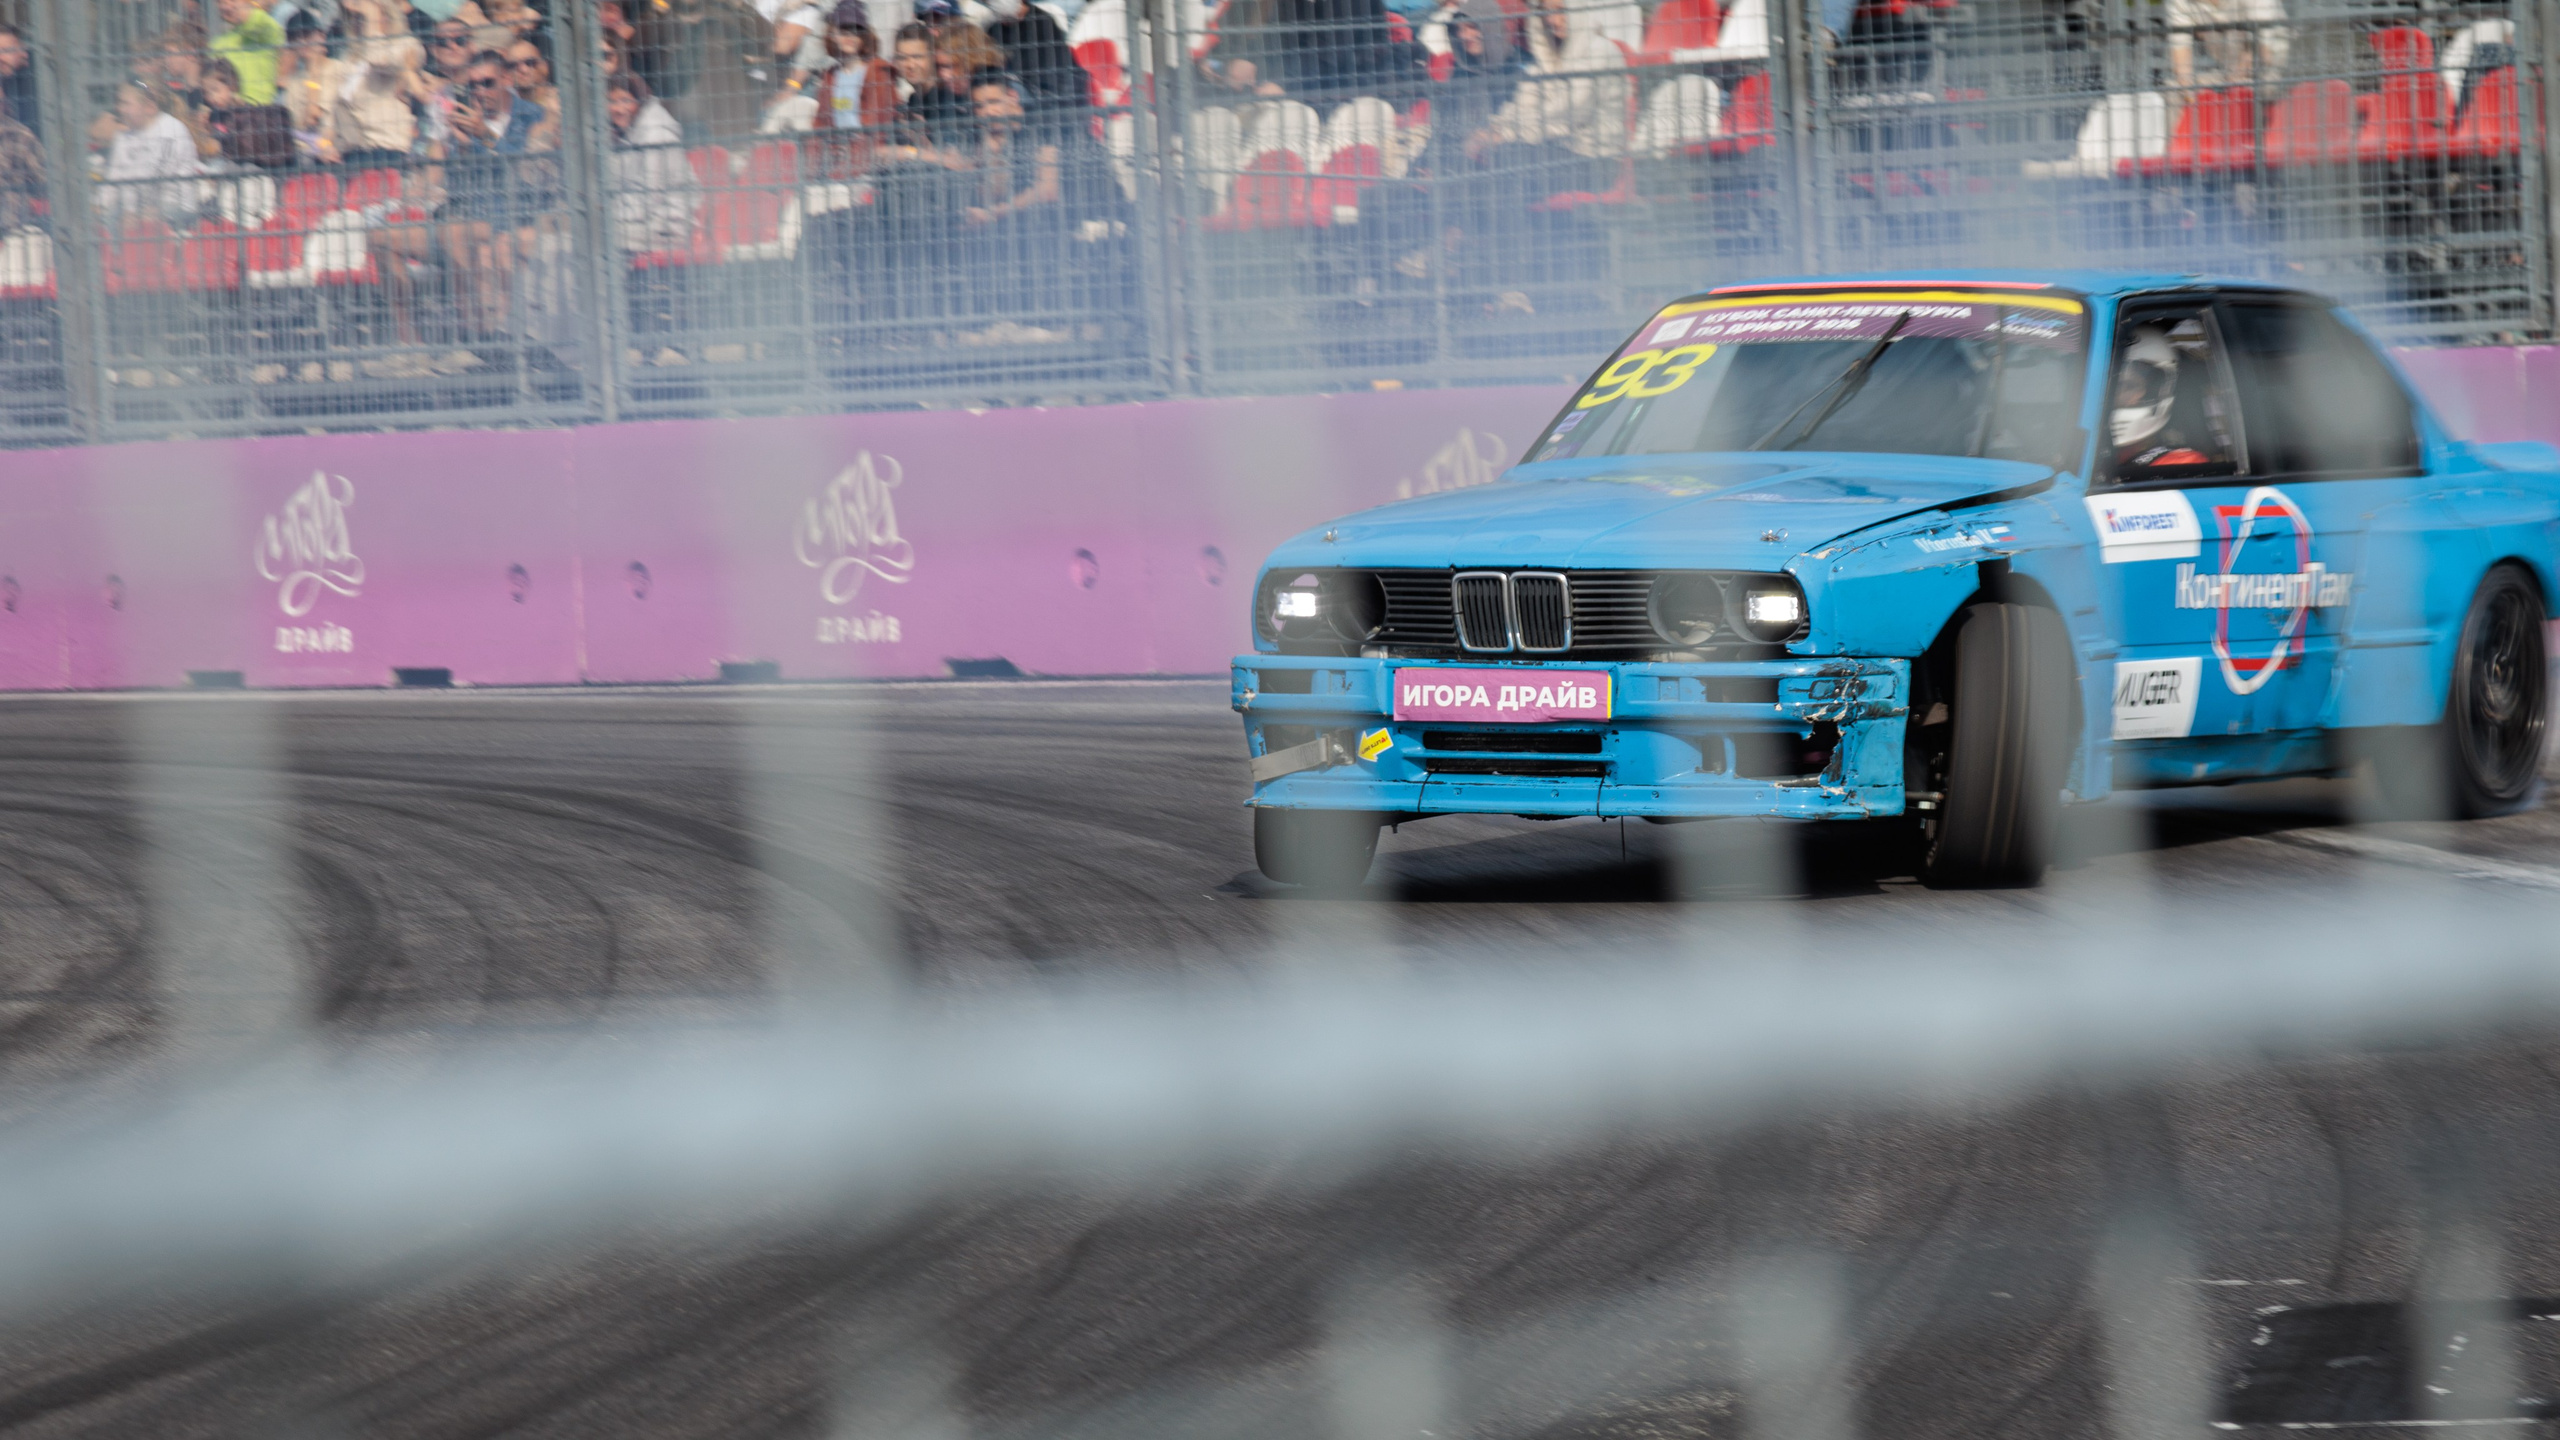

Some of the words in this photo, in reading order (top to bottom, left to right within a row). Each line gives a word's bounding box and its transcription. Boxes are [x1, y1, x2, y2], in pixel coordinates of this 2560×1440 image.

[1690, 325, 1725, 338] ПО
[1720, 319, 1814, 336] ДРИФТУ
[1700, 307, 1773, 325] КУБОК
[1770, 304, 1972, 319] САНКТ-ПЕТЕРБУРГА
[1575, 343, 1718, 410] 93
[274, 620, 354, 653] ДРАЙВ
[815, 608, 902, 643] ДРАЙВ
[1403, 685, 1490, 707] ИГОРА
[1497, 680, 1597, 711] ДРАЙВ
